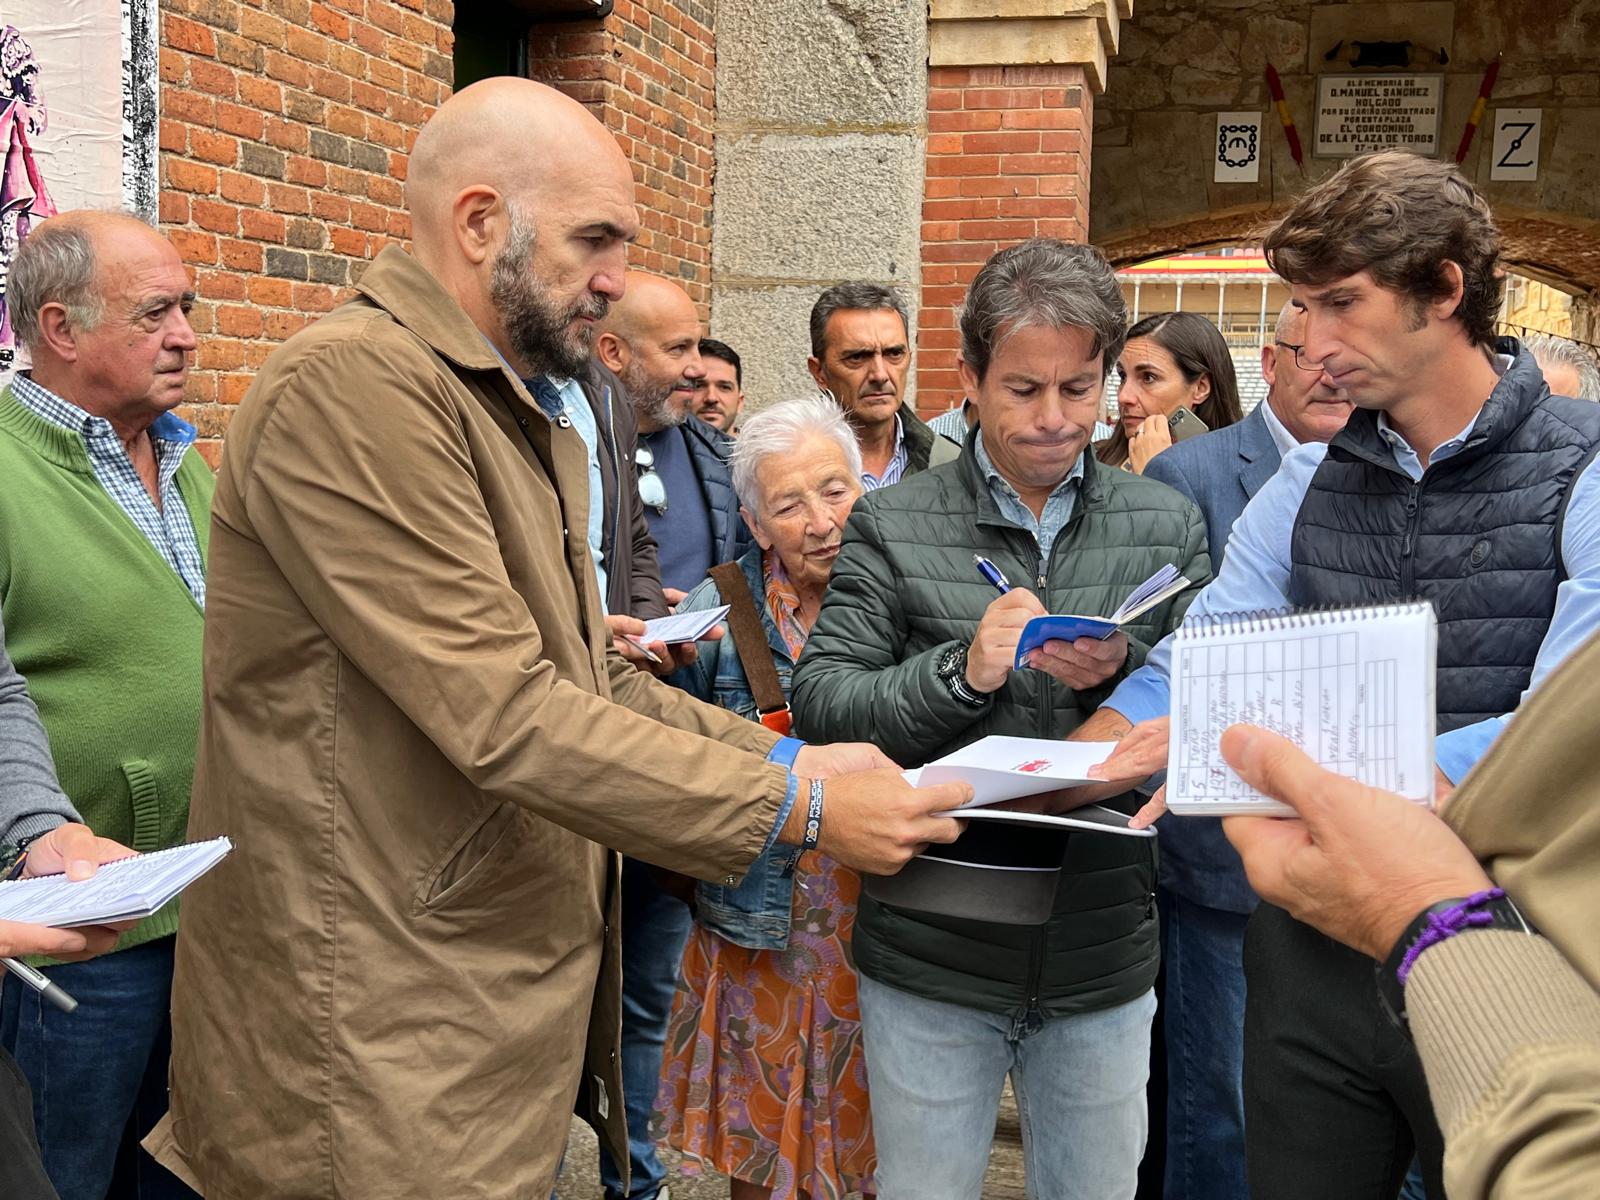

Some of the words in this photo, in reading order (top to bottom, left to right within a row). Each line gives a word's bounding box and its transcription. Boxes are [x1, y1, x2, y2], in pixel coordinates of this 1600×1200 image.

[1355, 98, 1401, 107] HOLGADO
[1320, 134, 1333, 143] DE
[1335, 134, 1347, 143] LA
[1351, 134, 1382, 142] PLAZA
[1386, 134, 1399, 142] DE
[1402, 134, 1434, 142] TOROS
